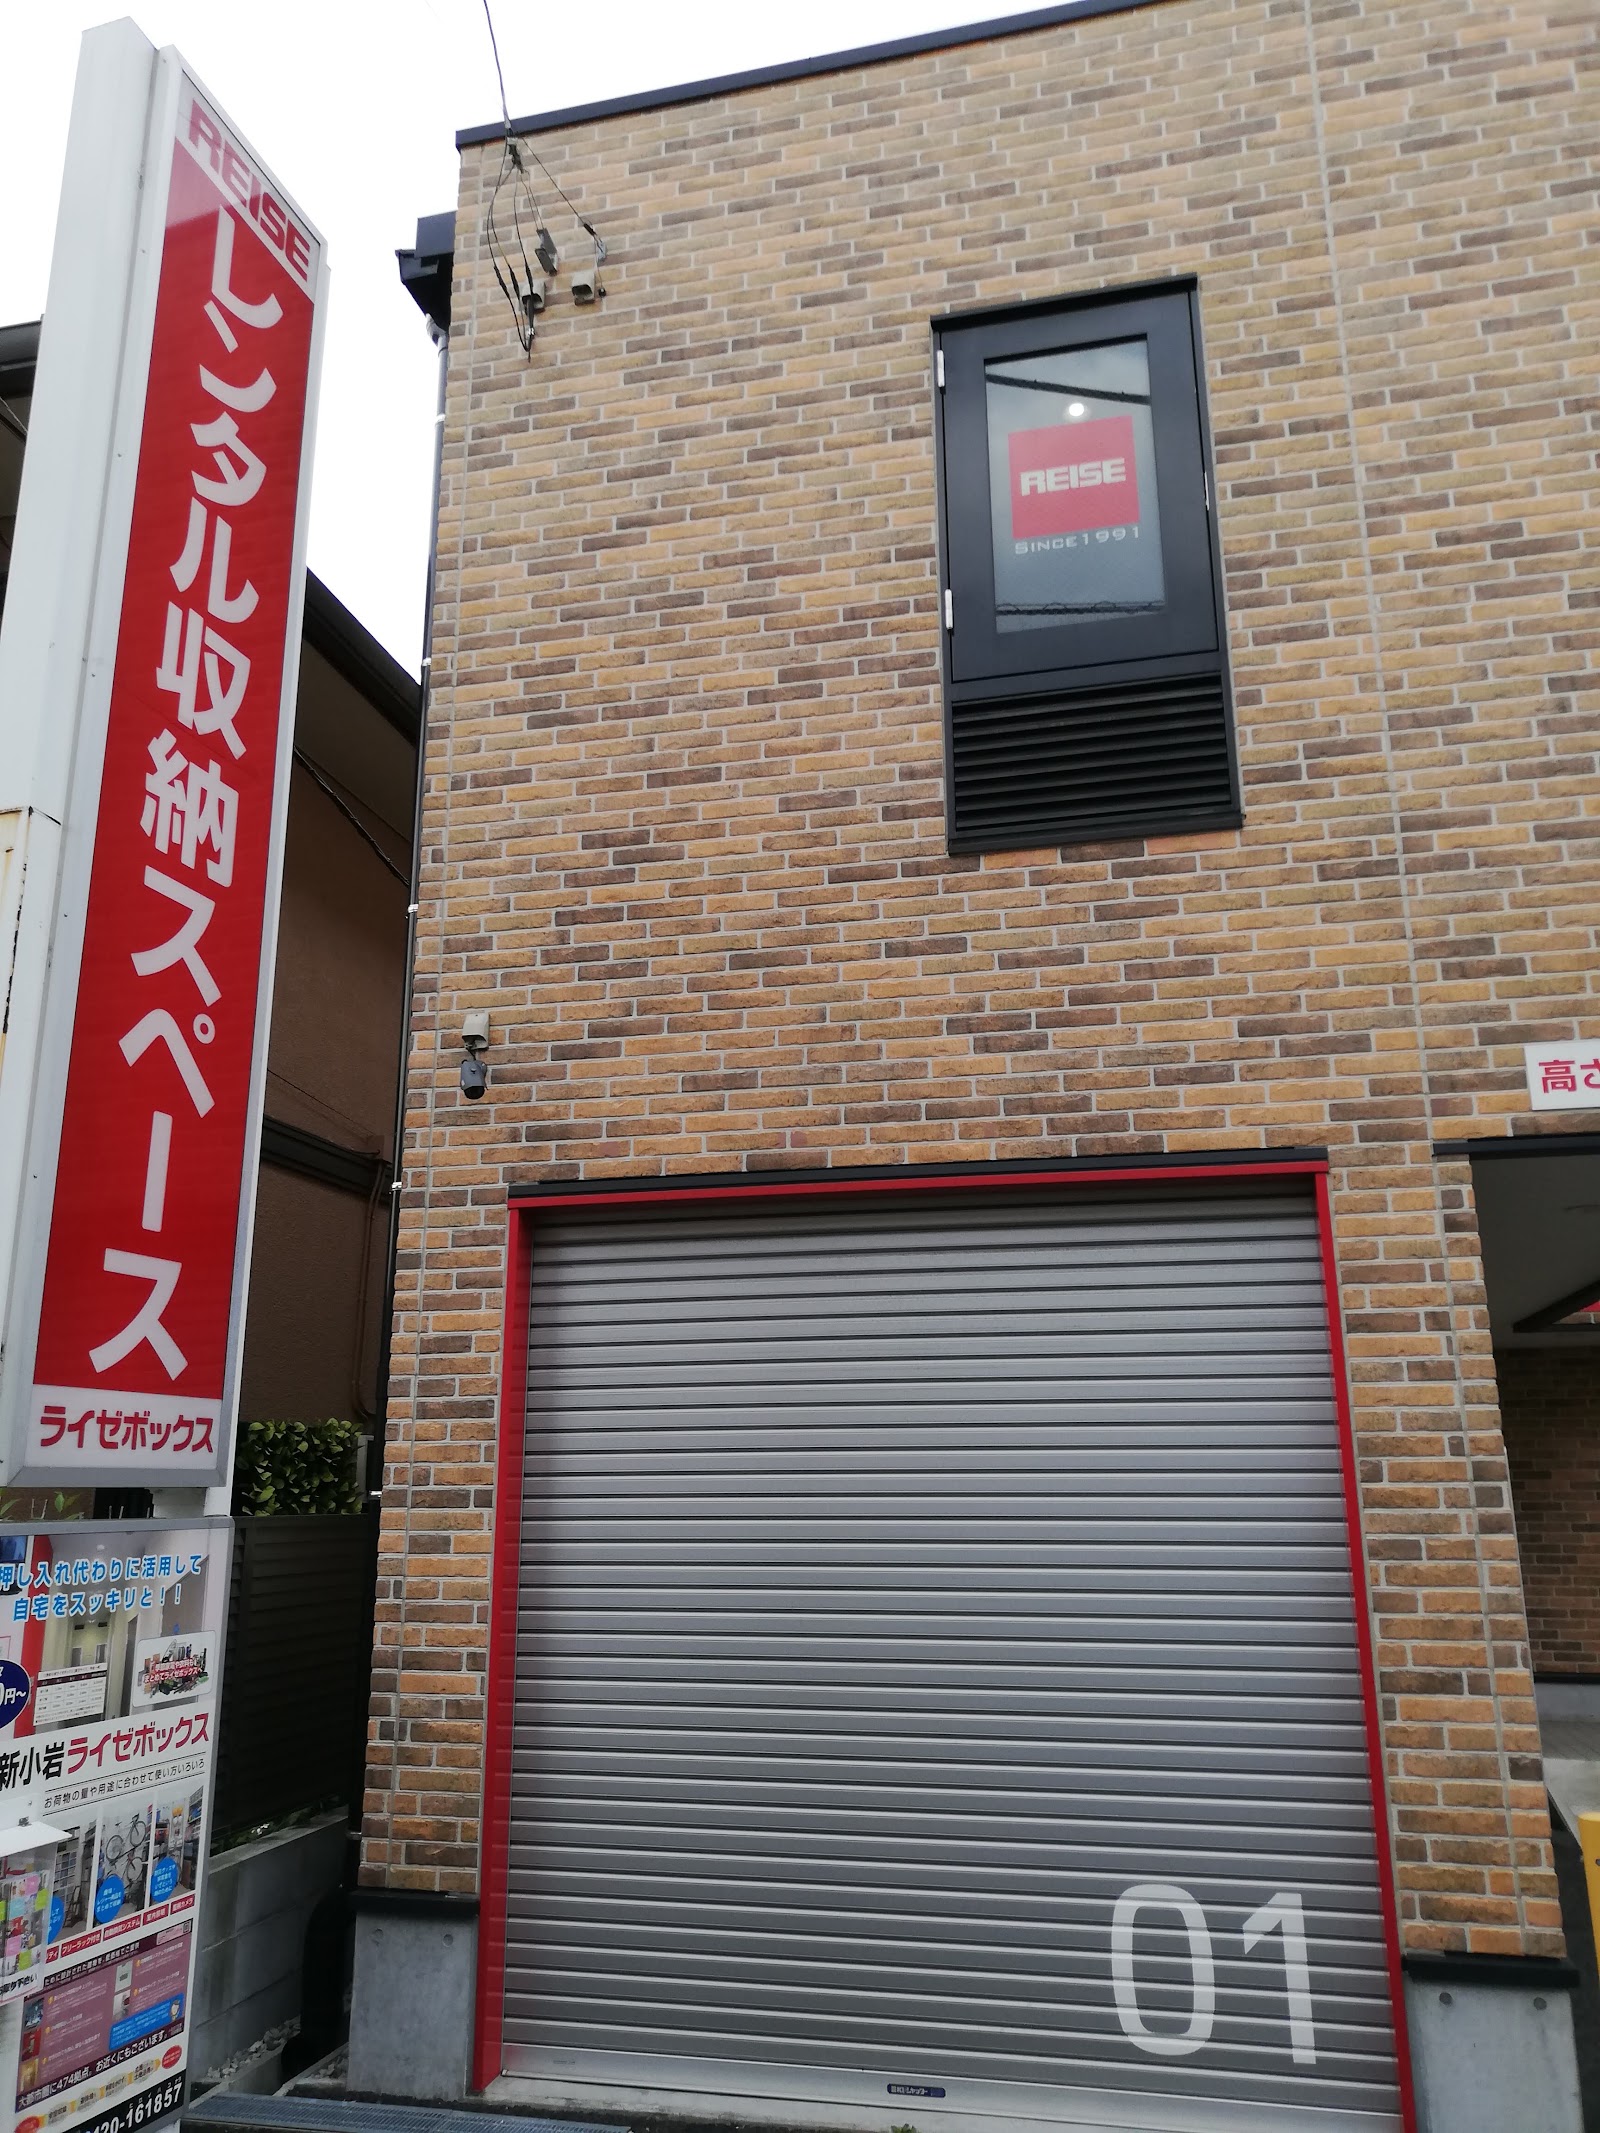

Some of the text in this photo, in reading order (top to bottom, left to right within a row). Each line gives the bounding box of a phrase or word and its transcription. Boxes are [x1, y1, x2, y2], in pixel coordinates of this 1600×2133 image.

[188, 100, 311, 283] REISE
[1020, 457, 1126, 497] REISE
[89, 204, 285, 1381] レンタル収納スペース
[40, 1405, 214, 1453] ライゼボックス
[0, 1554, 202, 1590] 押し入れ代わりに活用して
[43, 1758, 206, 1809] お荷物の量や用途に合わせて使い方いろいろ
[1111, 1883, 1317, 2065] 01
